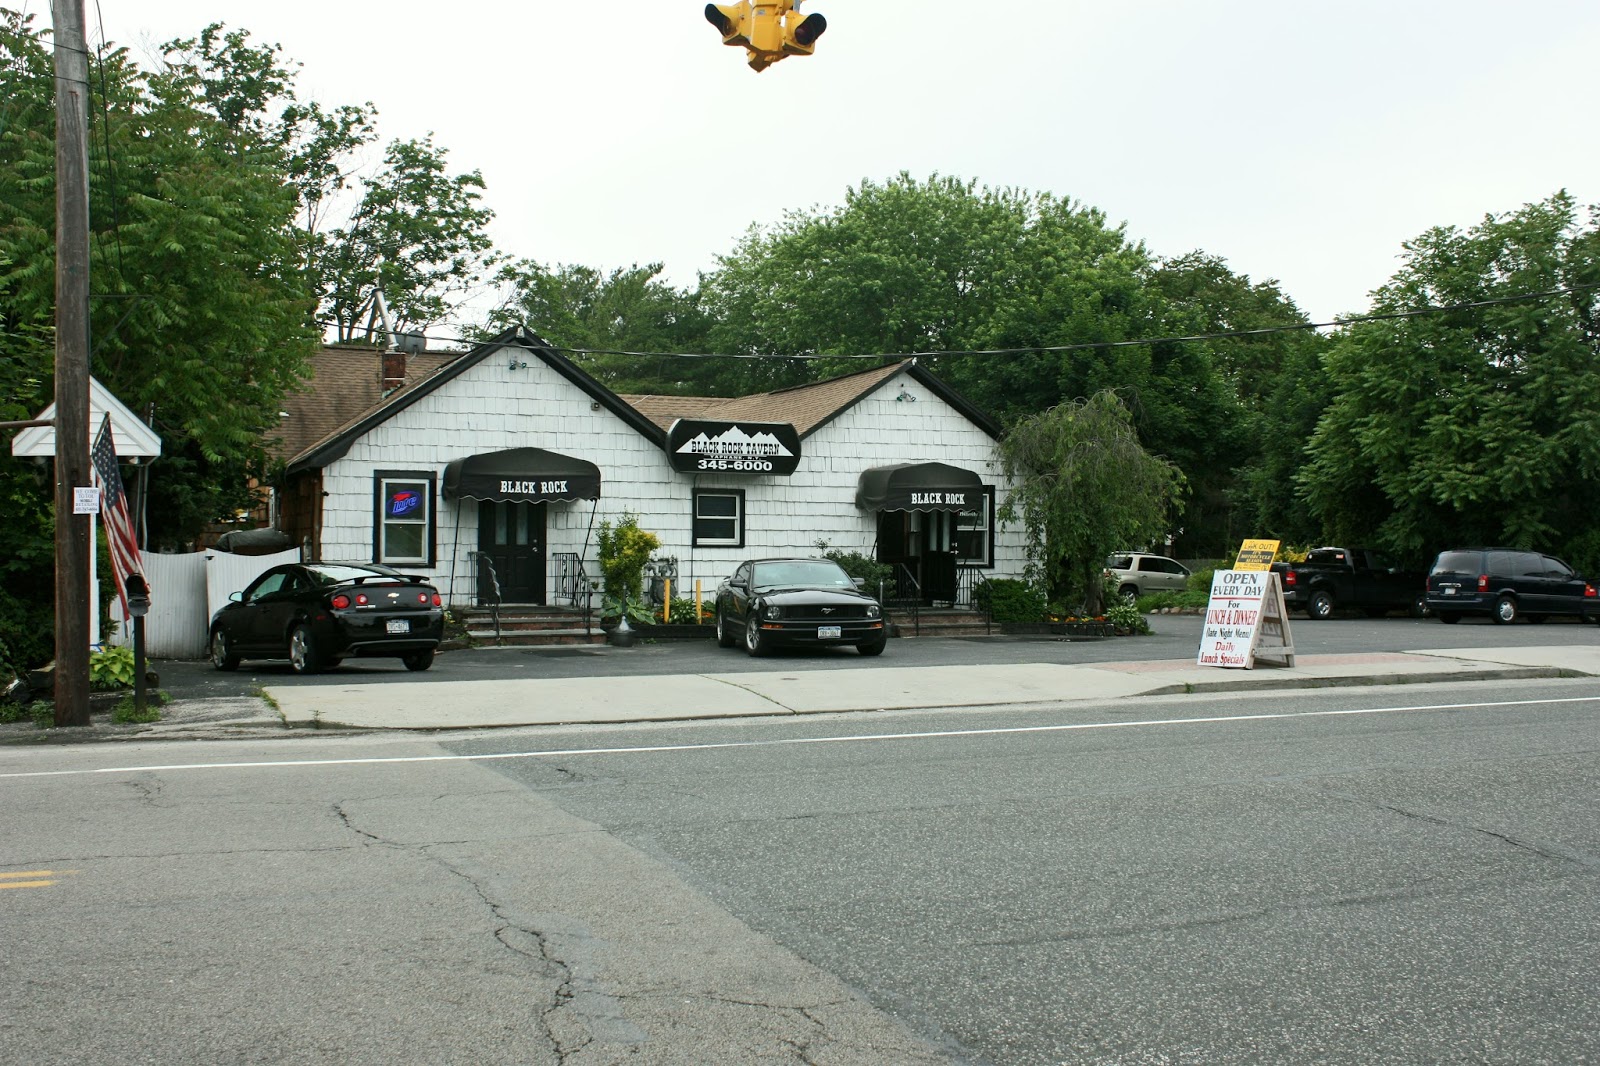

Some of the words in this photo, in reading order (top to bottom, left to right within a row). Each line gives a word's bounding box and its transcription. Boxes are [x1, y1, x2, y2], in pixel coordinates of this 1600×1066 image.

[691, 441, 719, 453] BLACK
[722, 442, 743, 454] ROCK
[746, 443, 780, 455] TAVERN
[698, 459, 773, 471] 345-6000
[500, 480, 536, 494] BLACK
[540, 480, 568, 494] ROCK
[911, 493, 942, 504] BLACK
[945, 493, 965, 505] ROCK
[1224, 573, 1258, 584] OPEN
[1213, 585, 1241, 596] EVERY
[1243, 586, 1264, 596] DAY
[1207, 610, 1226, 625] LUNCH
[1226, 611, 1231, 625] &
[1232, 610, 1258, 626] DINNER
[1219, 627, 1233, 640] Night
[1215, 642, 1235, 652] Daily
[1200, 651, 1219, 664] Lunch
[1219, 651, 1245, 666] Specials
